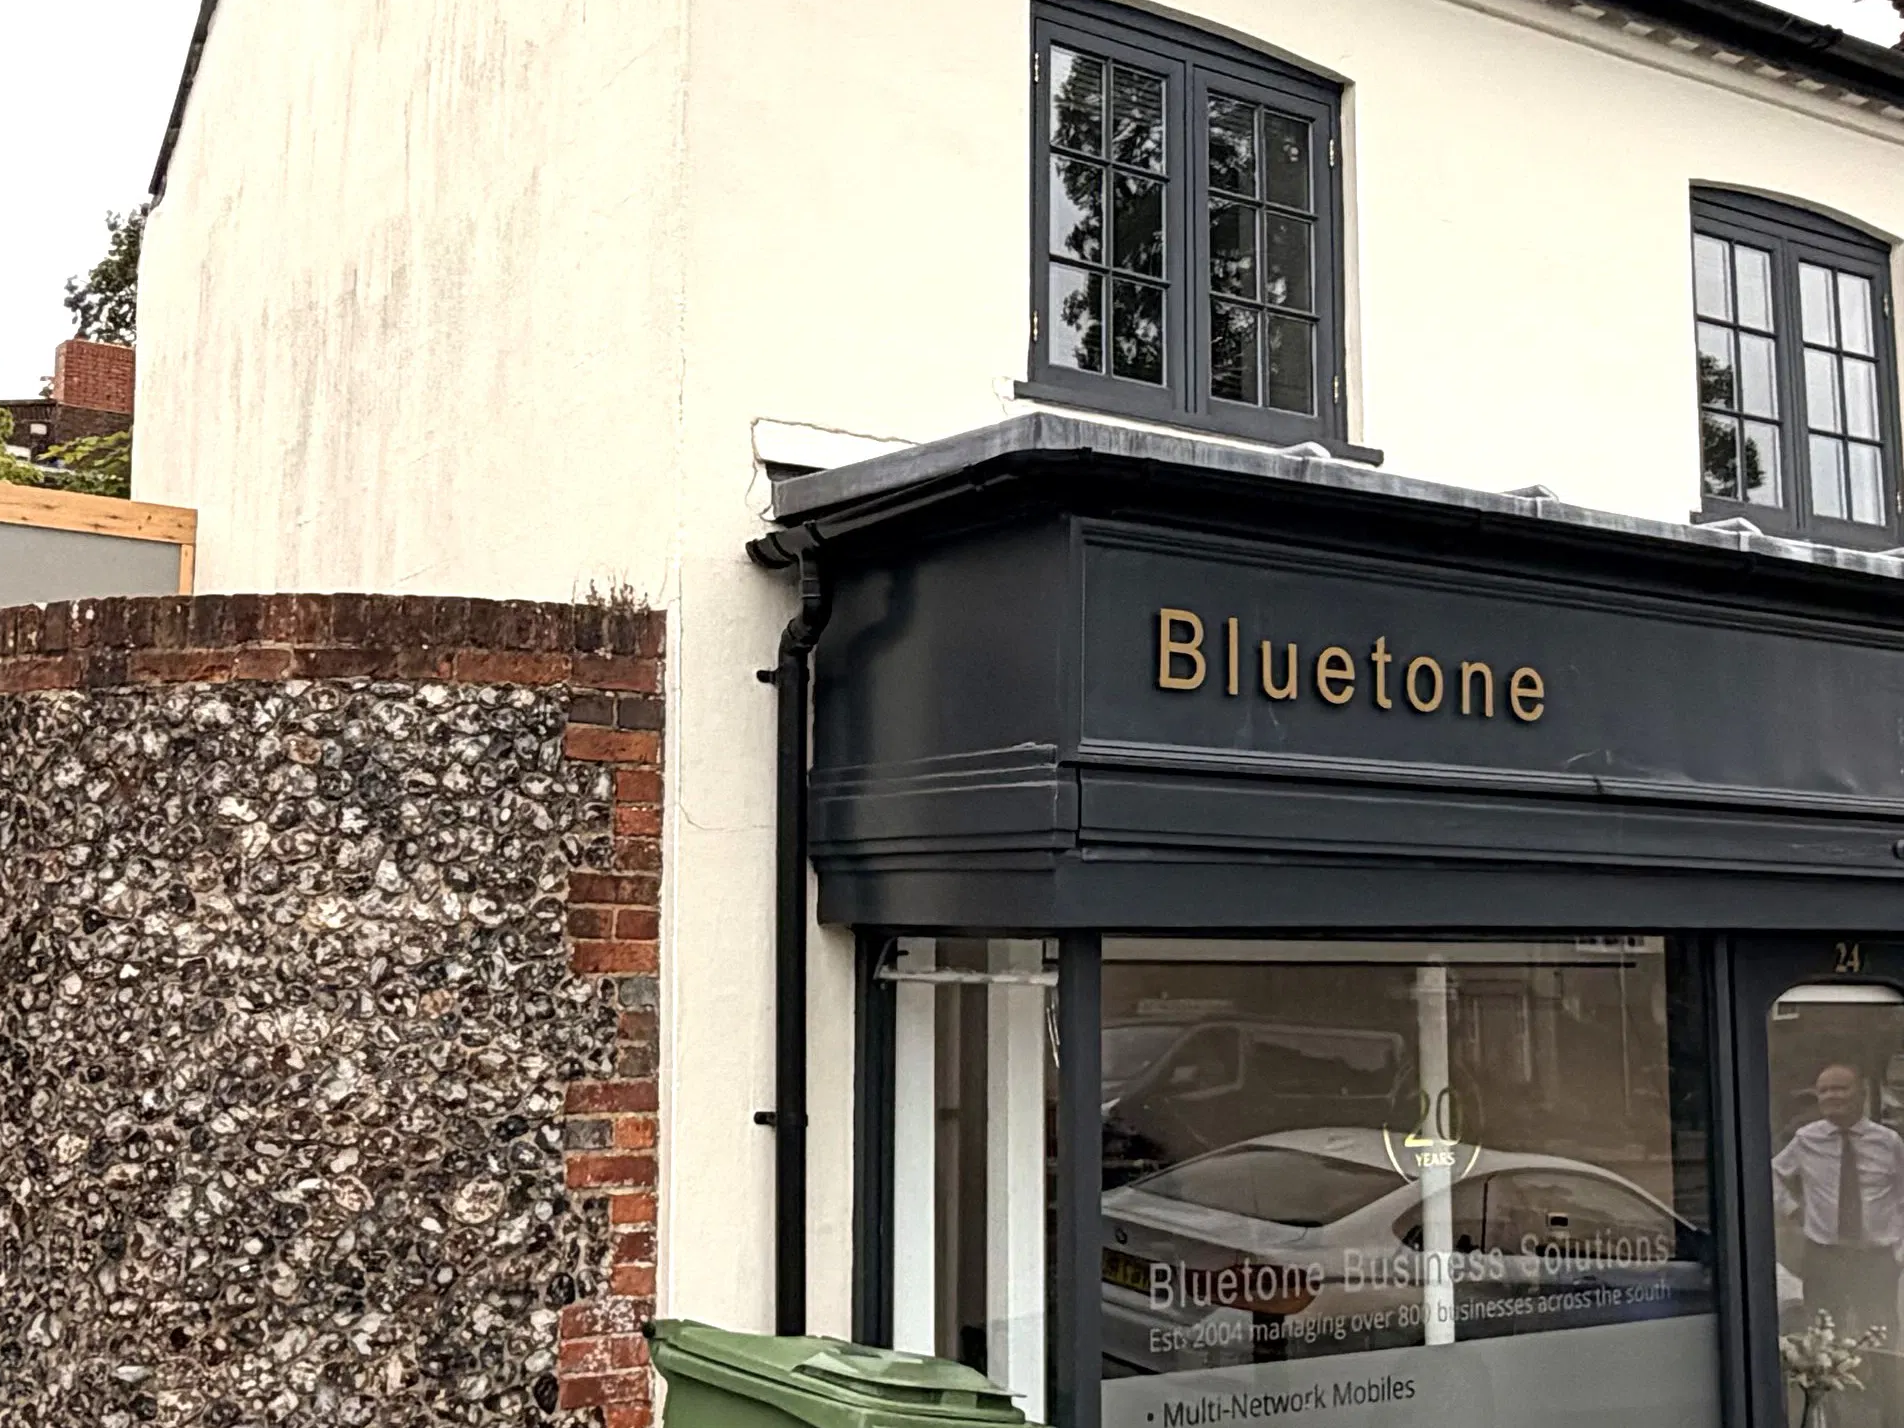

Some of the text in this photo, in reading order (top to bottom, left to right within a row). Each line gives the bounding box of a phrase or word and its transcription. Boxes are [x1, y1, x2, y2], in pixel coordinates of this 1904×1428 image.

[1158, 607, 1546, 721] Bluetone
[1836, 942, 1860, 972] 24
[1404, 1088, 1463, 1147] 20
[1415, 1152, 1456, 1168] YEARS
[1149, 1257, 1325, 1310] Bluetone
[1343, 1243, 1507, 1292] Business
[1521, 1229, 1671, 1279] Solutions
[1193, 1320, 1242, 1348] 2004
[1248, 1313, 1346, 1344] managing
[1351, 1309, 1394, 1332] over
[1437, 1295, 1533, 1323] businesses
[1537, 1289, 1591, 1314] across
[1595, 1284, 1622, 1308] the
[1625, 1278, 1671, 1304] south
[1163, 1375, 1416, 1428] Multi-Network Mobiles
